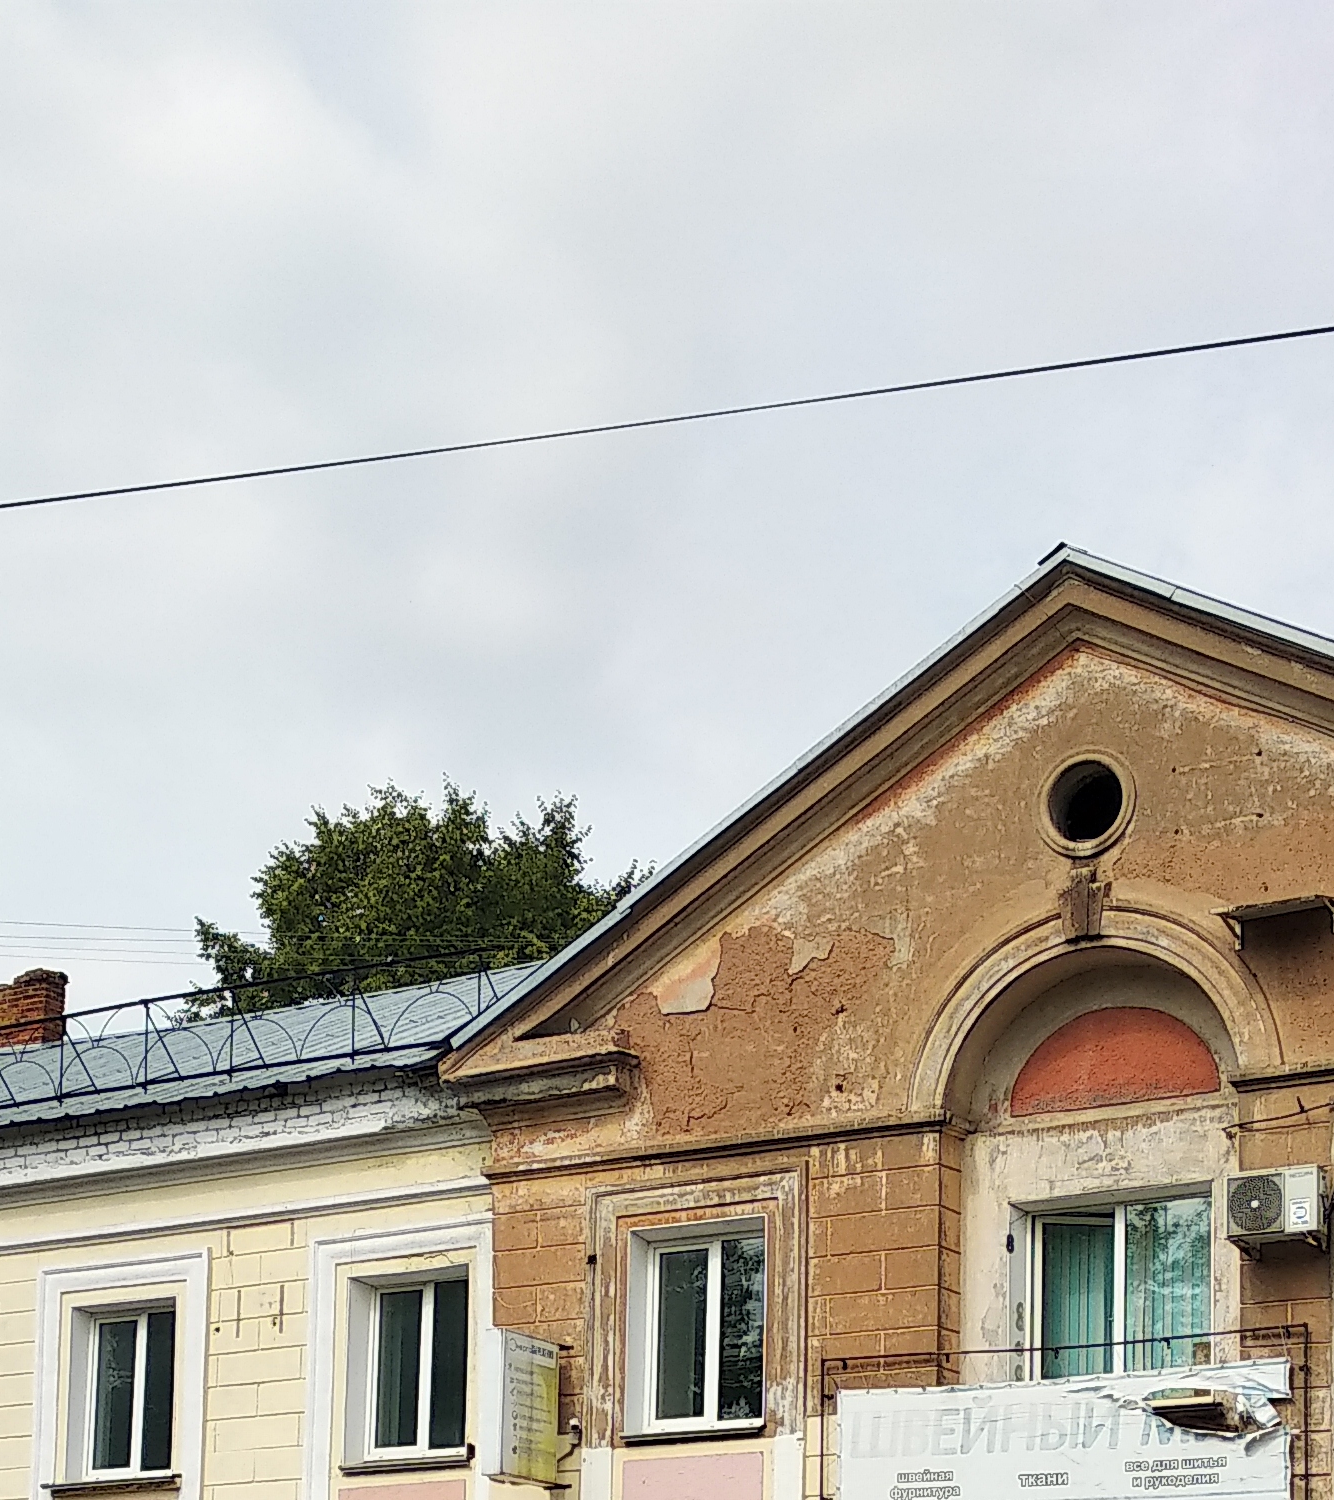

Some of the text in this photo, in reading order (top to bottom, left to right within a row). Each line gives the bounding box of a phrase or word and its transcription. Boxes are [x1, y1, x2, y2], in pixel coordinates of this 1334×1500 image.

[1124, 1456, 1228, 1473] все для шитья
[897, 1469, 954, 1484] швейная
[1018, 1472, 1069, 1488] ткани
[1132, 1472, 1219, 1490] и рукоделия
[889, 1484, 960, 1500] фурнитура
